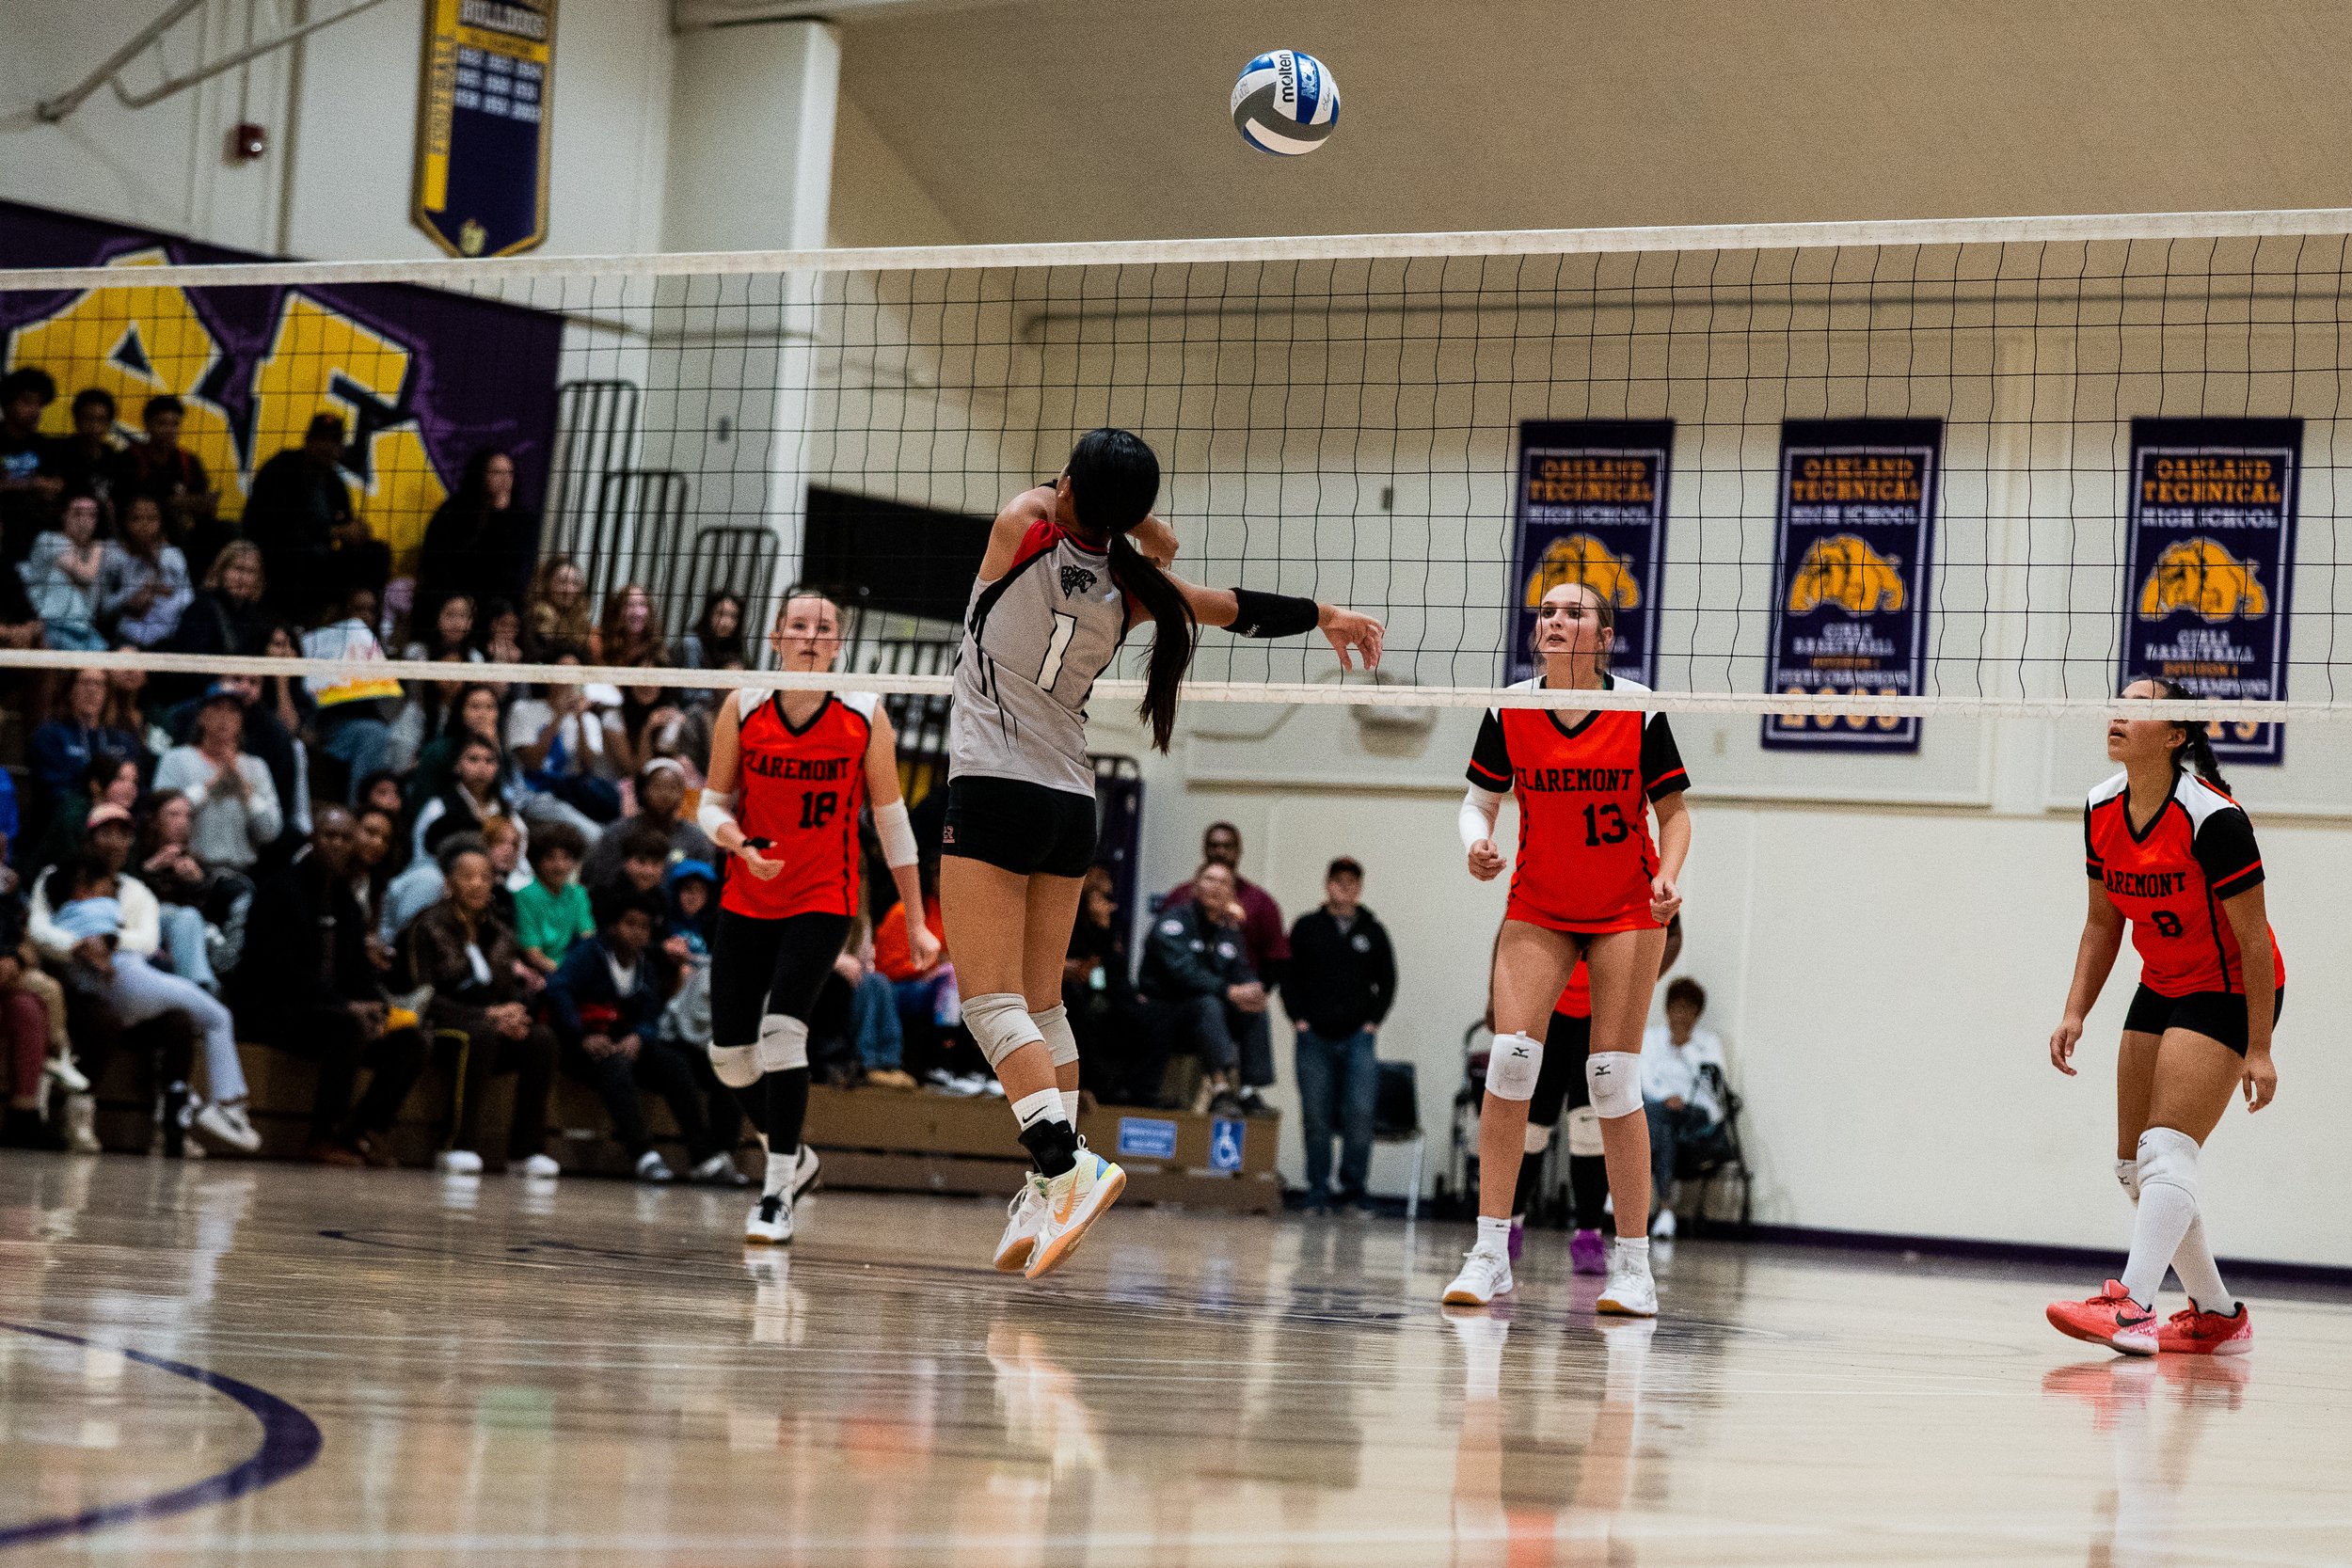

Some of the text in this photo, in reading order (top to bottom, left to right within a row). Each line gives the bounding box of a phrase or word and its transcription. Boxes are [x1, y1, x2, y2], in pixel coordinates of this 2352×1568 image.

[1279, 54, 1295, 103] molten
[2156, 459, 2272, 481] OAKLAND
[1791, 480, 1919, 501] TECHNICAL
[2143, 481, 2280, 503] TECHNICAL
[1036, 608, 1077, 693] 1
[1582, 802, 1629, 847] 13
[2106, 868, 2186, 898] AREMONT
[2151, 910, 2184, 938] 8
